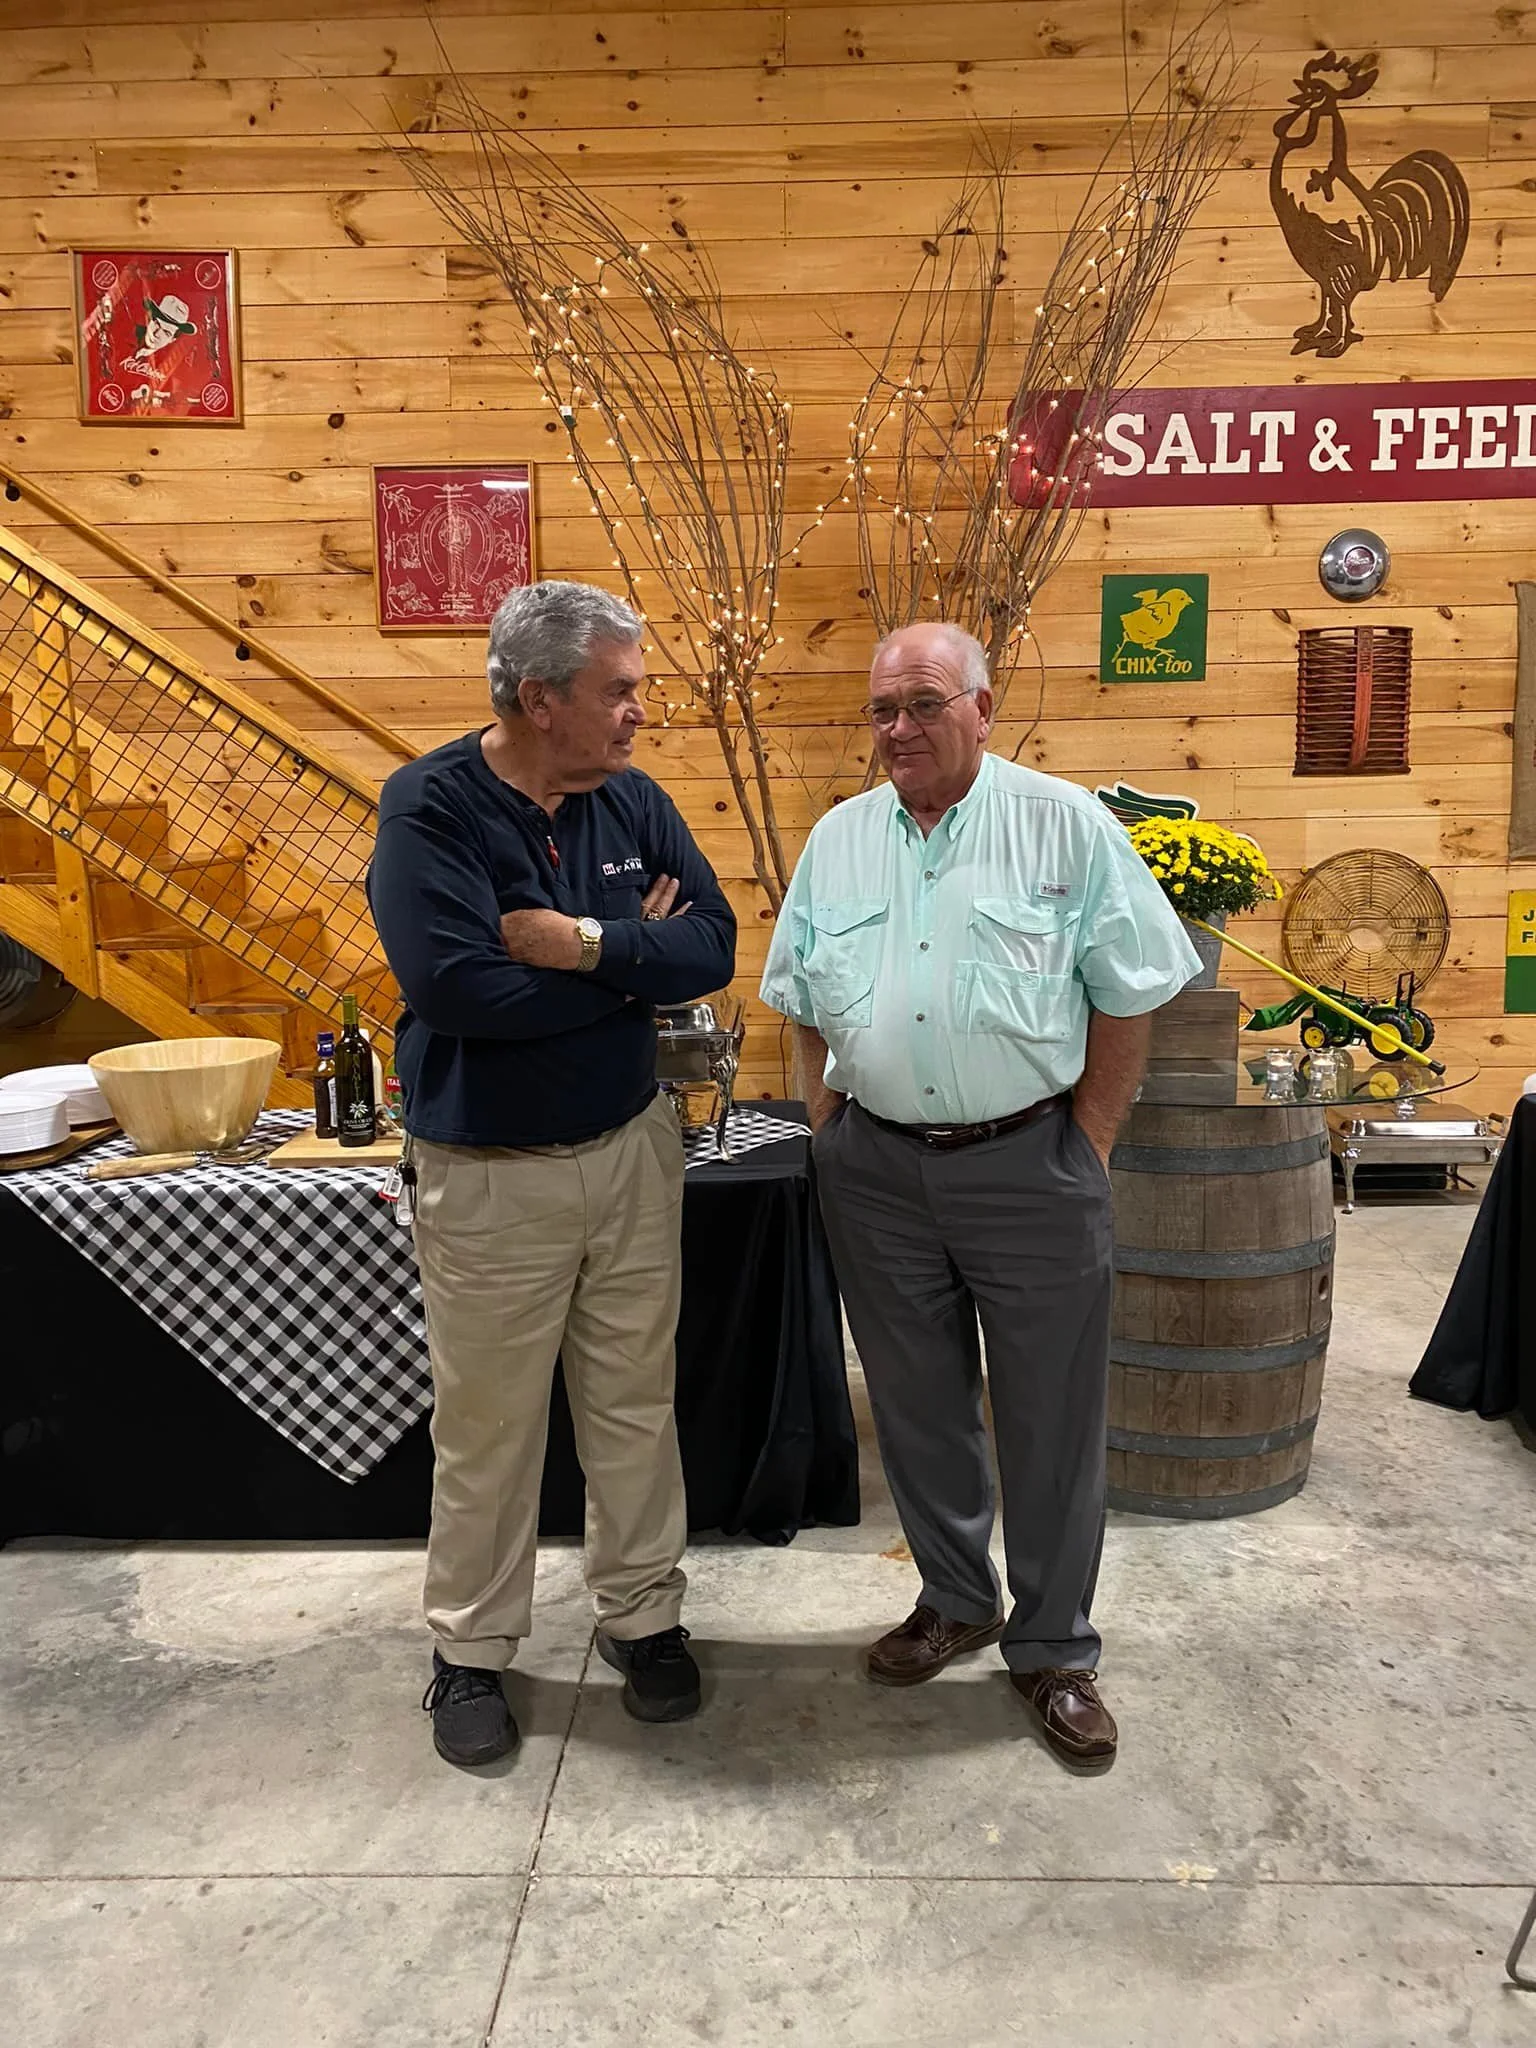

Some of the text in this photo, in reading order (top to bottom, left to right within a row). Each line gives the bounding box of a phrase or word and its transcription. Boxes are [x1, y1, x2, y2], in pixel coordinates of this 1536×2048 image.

[1103, 411, 1296, 476] SALT
[1308, 418, 1354, 472] &
[1115, 656, 1193, 675] CHIX-too
